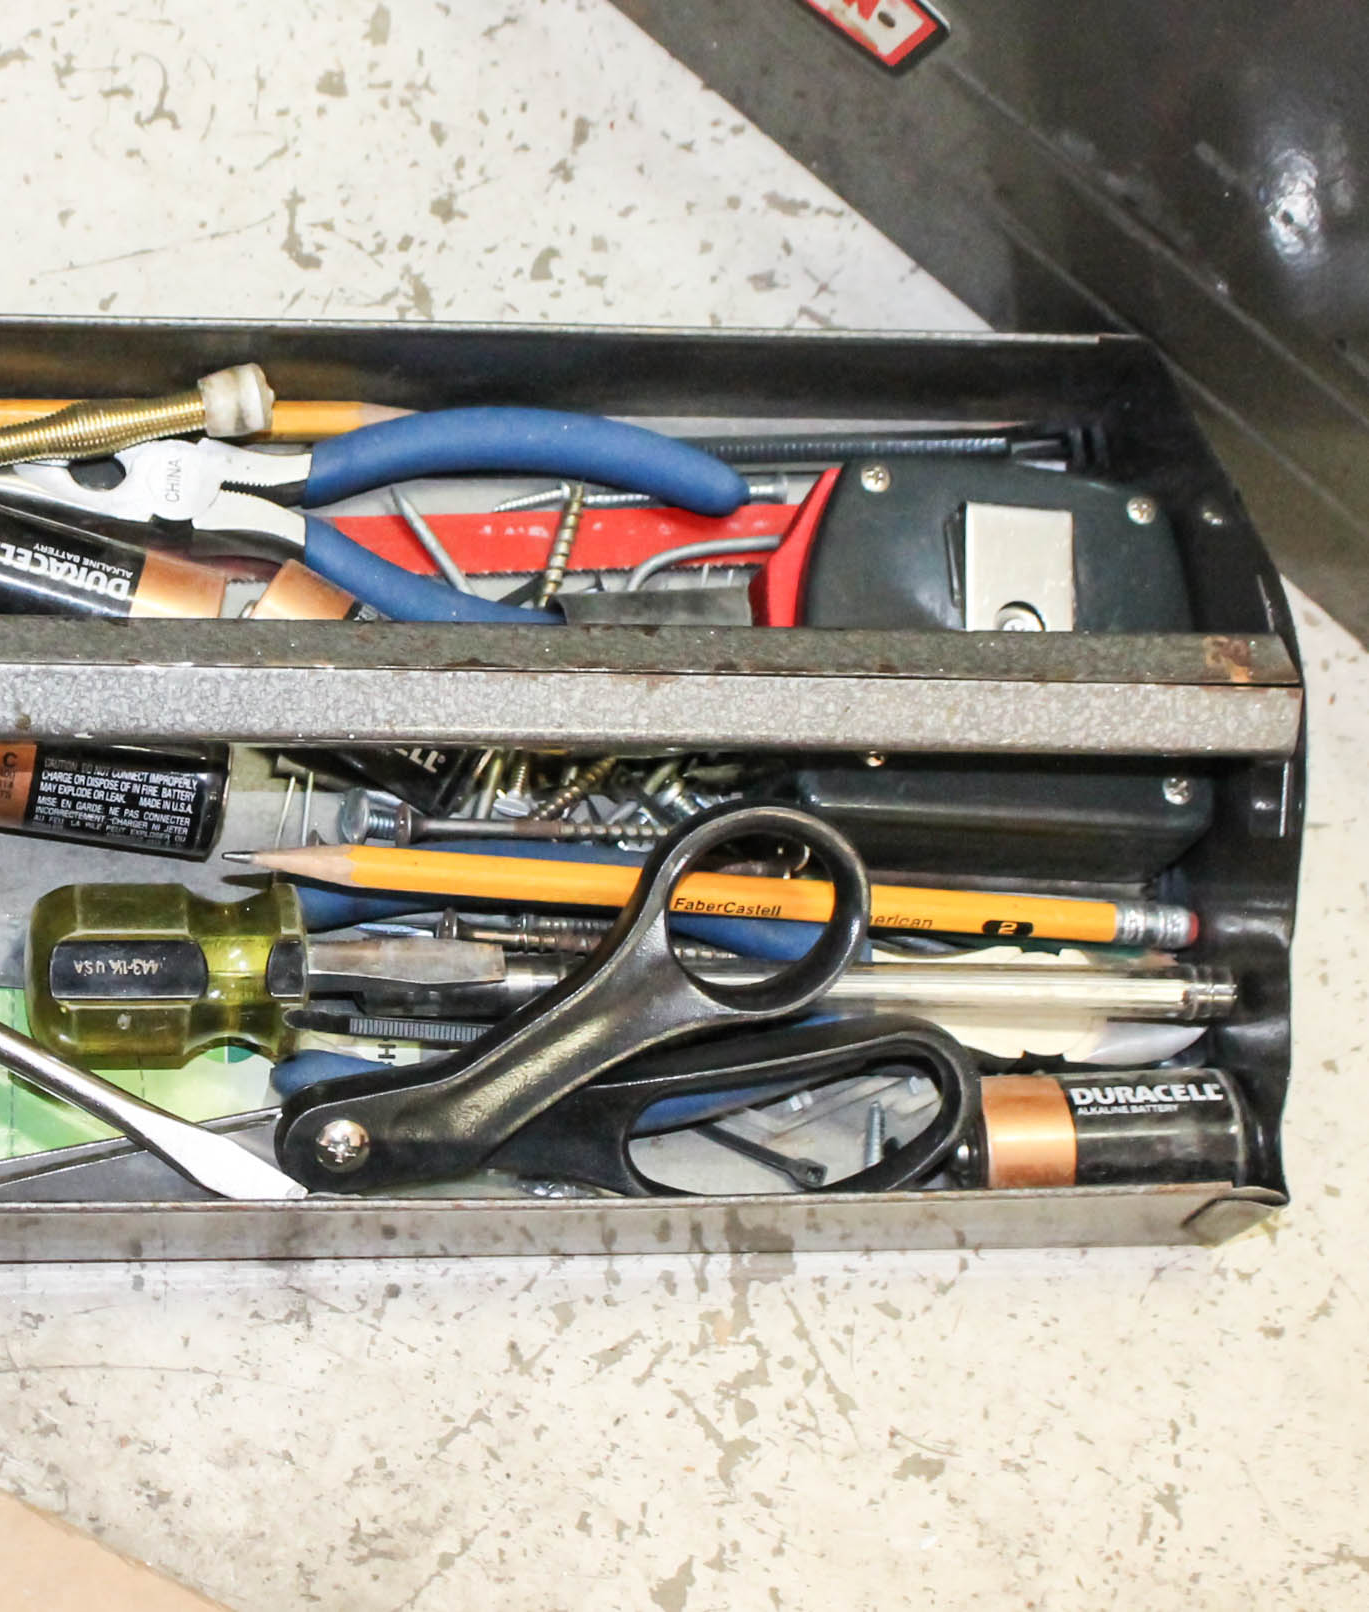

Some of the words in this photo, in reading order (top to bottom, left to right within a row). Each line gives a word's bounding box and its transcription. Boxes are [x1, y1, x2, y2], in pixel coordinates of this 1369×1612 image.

[165, 459, 182, 503] CHINA
[33, 543, 81, 564] BATTERY
[82, 556, 134, 579] ALKALINE
[3, 752, 17, 767] C
[42, 770, 73, 784] CHARGE
[74, 774, 85, 786] OR
[87, 776, 119, 791] DISPOSE
[120, 781, 132, 792] OF
[132, 783, 141, 794] IN
[161, 788, 196, 803] BATTERY
[94, 765, 111, 777] NOT
[111, 769, 149, 782] CONNECT
[149, 773, 198, 791] IMPROPERLY
[39, 781, 57, 793] MAY
[58, 784, 92, 799] EXPLODE
[93, 789, 105, 800] OR
[138, 796, 161, 810] MADE
[161, 800, 171, 810] IN
[37, 796, 58, 807] MISE
[61, 799, 72, 809] EN
[109, 806, 121, 816] NE
[124, 808, 140, 819] PAS
[143, 811, 191, 826] CONNECTER
[152, 823, 160, 832] NI
[164, 825, 189, 836] JETER
[673, 897, 782, 916] FaberCastell
[869, 914, 933, 929] erican
[997, 921, 1018, 935] 2
[1069, 1083, 1224, 1105] DURACELL
[1077, 1106, 1130, 1115] ALKALINE
[1132, 1104, 1179, 1114] BATTERY
